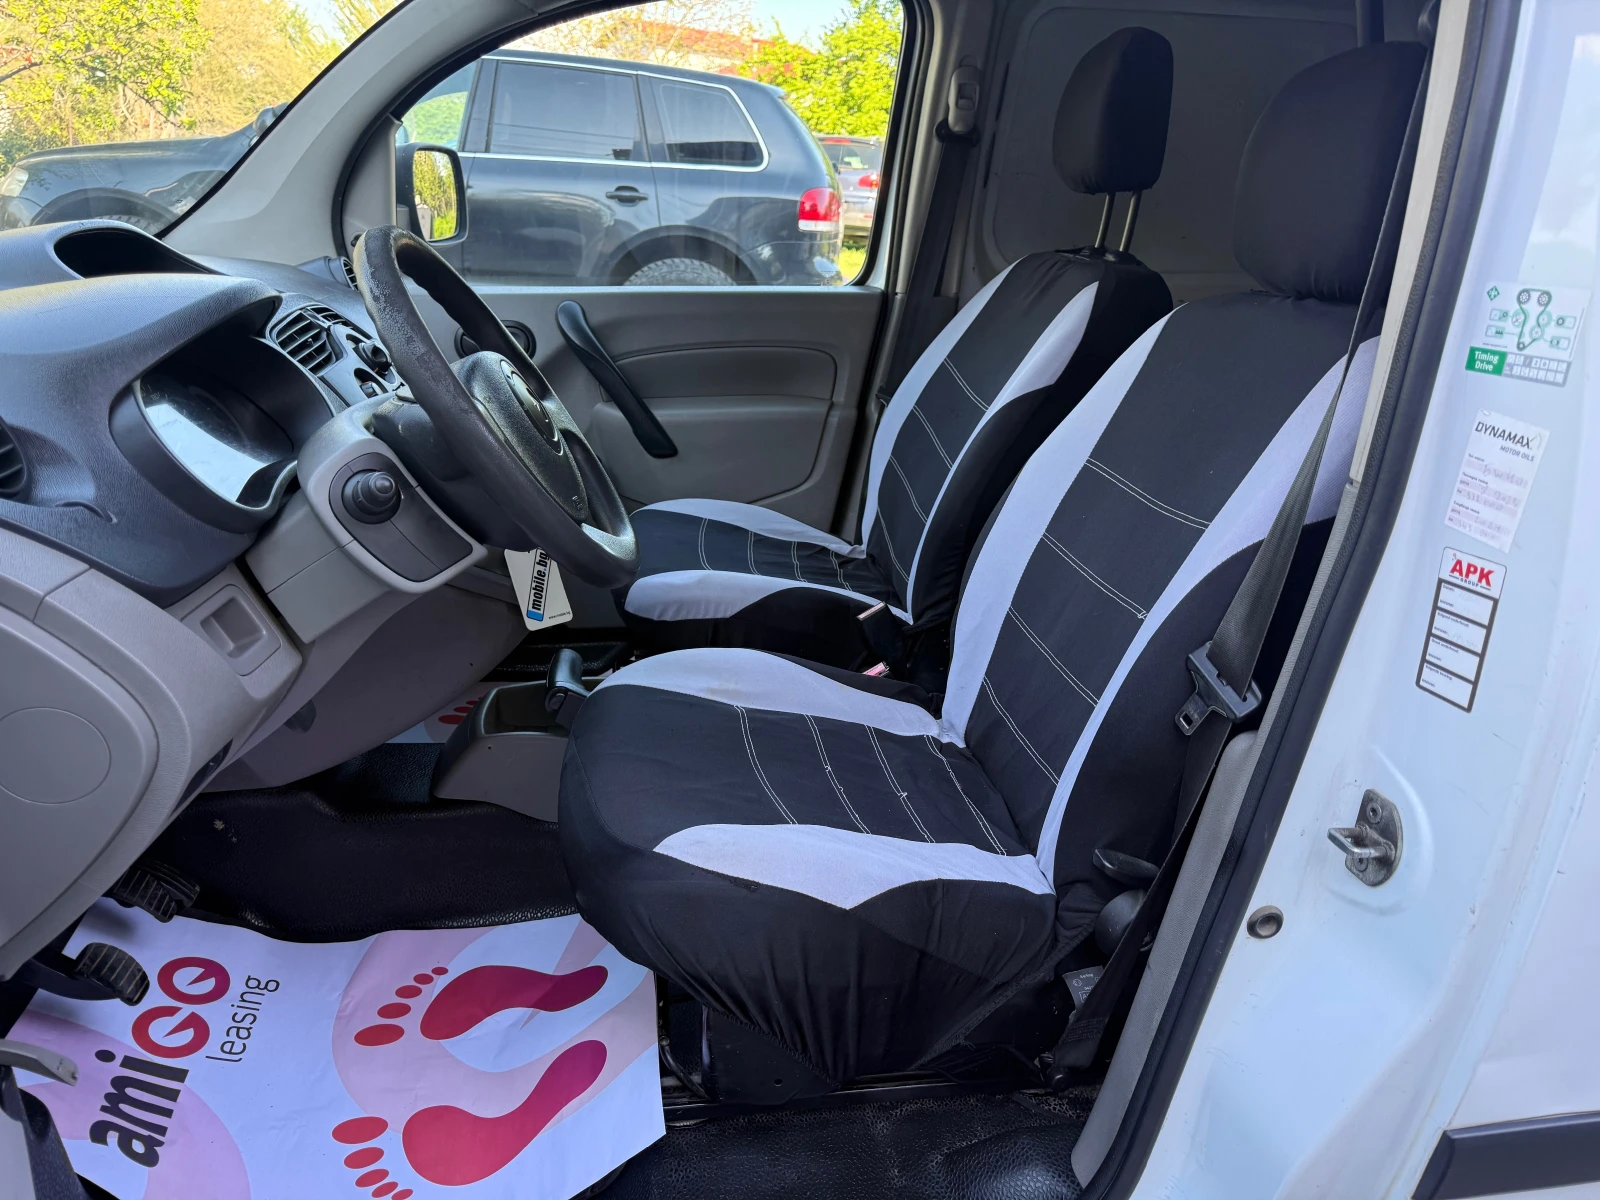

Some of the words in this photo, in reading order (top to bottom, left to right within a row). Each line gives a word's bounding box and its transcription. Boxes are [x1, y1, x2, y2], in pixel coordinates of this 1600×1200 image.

[1474, 350, 1499, 364] Timing
[1474, 360, 1494, 371] Drive
[1475, 421, 1534, 449] DYNAMAX
[1499, 445, 1521, 458] MOTOR
[1520, 452, 1535, 462] OILS
[531, 551, 550, 611] mobile.bg
[1449, 558, 1495, 588] APK
[1459, 577, 1480, 588] GROUP
[205, 974, 281, 1063] leasing
